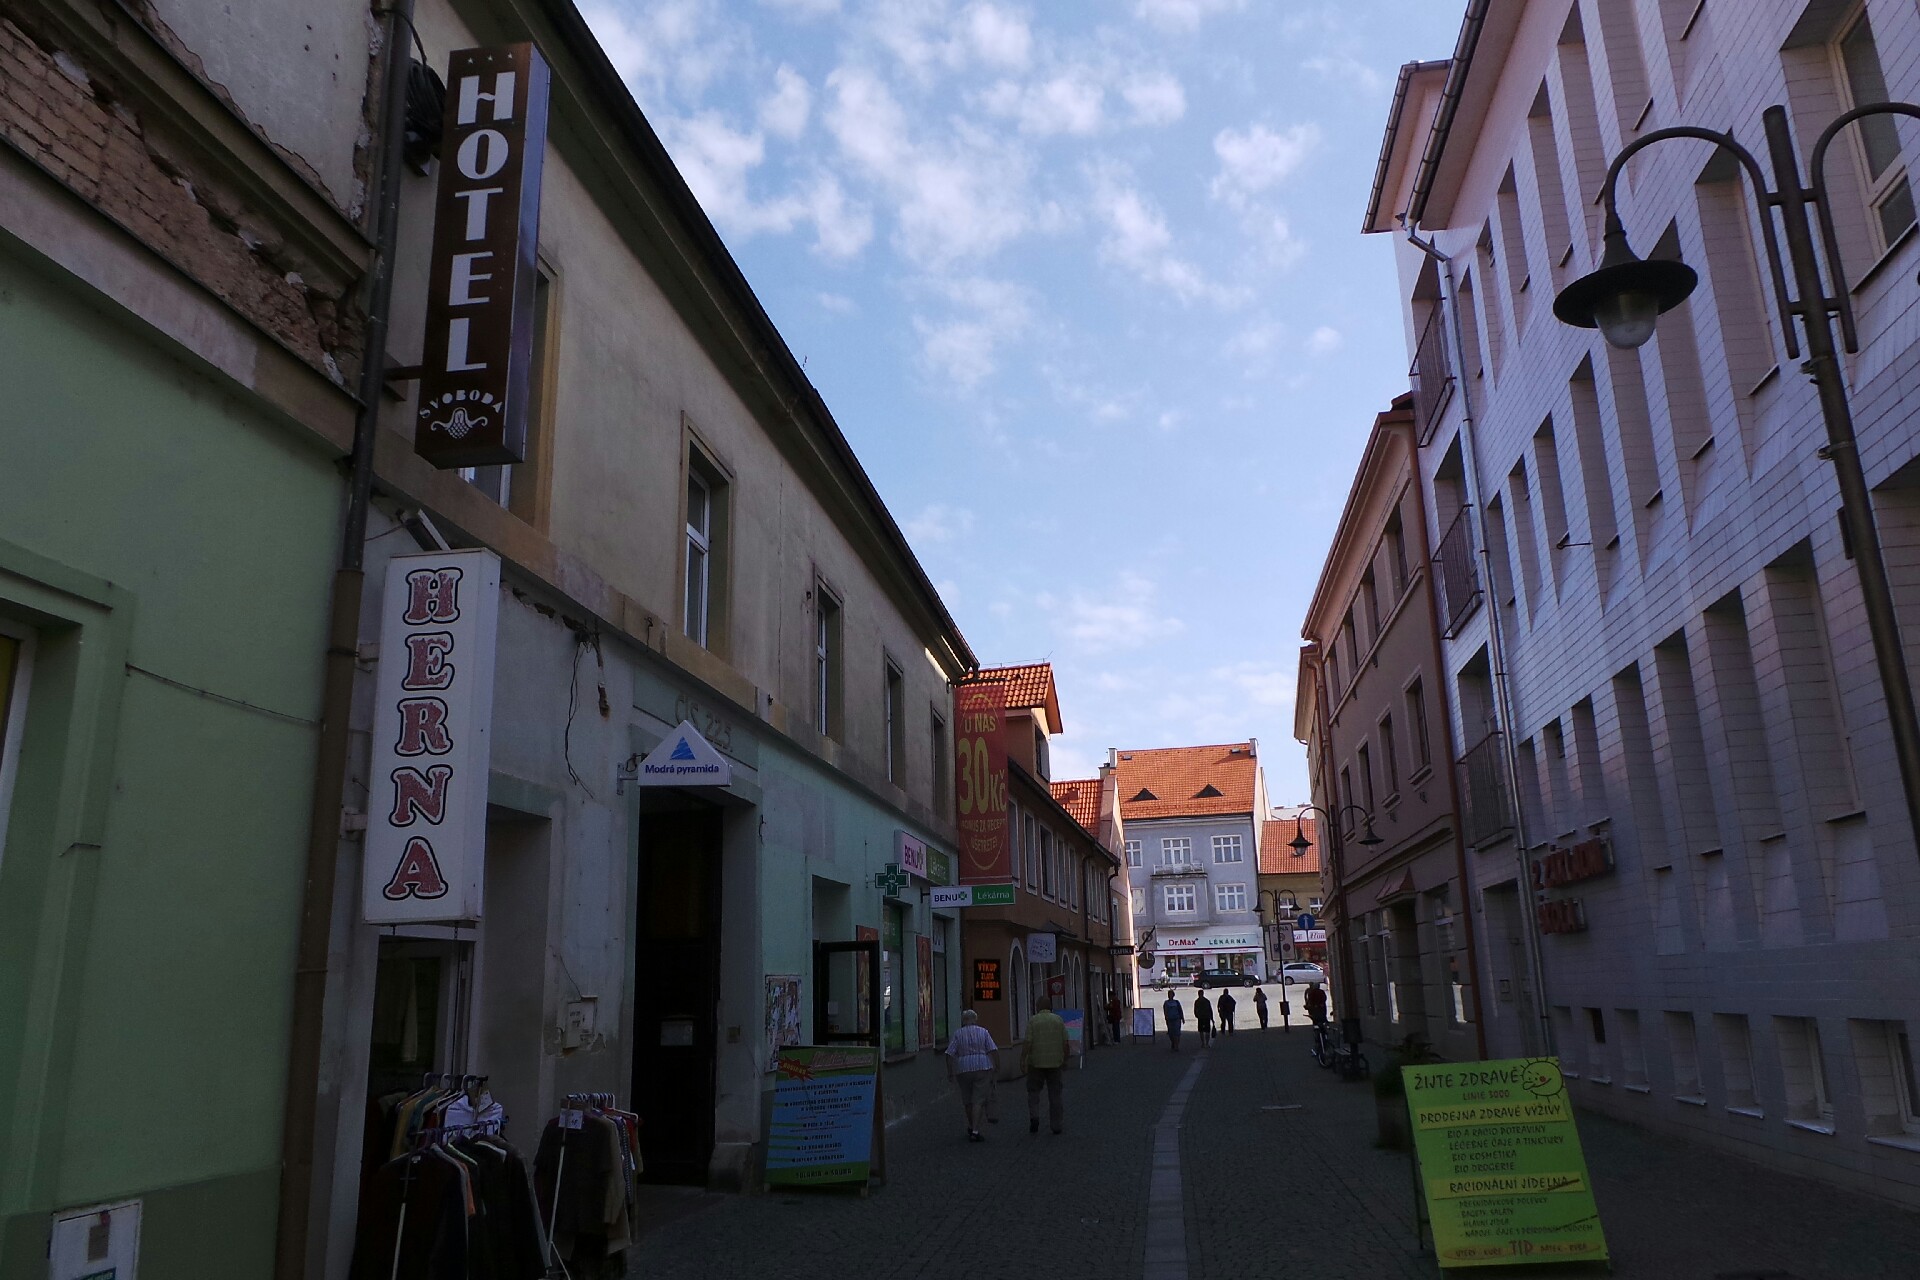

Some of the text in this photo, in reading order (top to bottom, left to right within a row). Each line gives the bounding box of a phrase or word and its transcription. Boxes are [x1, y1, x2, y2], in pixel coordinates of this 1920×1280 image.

[446, 71, 516, 372] HOTEL
[419, 389, 503, 419] SVOBODA
[384, 567, 463, 900] HERNA
[645, 763, 719, 775] Modrá pyramida
[958, 736, 990, 815] 30
[904, 844, 919, 869] BENU
[934, 891, 1010, 903] BENU Lékárna
[1168, 939, 1196, 947] Dr.Max
[1414, 1072, 1452, 1090] ŽIJTE
[1463, 1092, 1486, 1101] LINIE
[1421, 1102, 1561, 1124] PRODEJNA ZDRAVÉ VÝŽIVY
[1447, 1124, 1546, 1139] BIO A RACIO POTRAVINY
[1523, 1135, 1564, 1145] TINKTURY
[1452, 1150, 1517, 1162] BIO KOSMETIKA
[1454, 1161, 1515, 1173] BIO DROGERIE
[1449, 1176, 1567, 1193] RACIONÁLNÍ JÍDELNA
[1508, 1240, 1534, 1257] TIP
